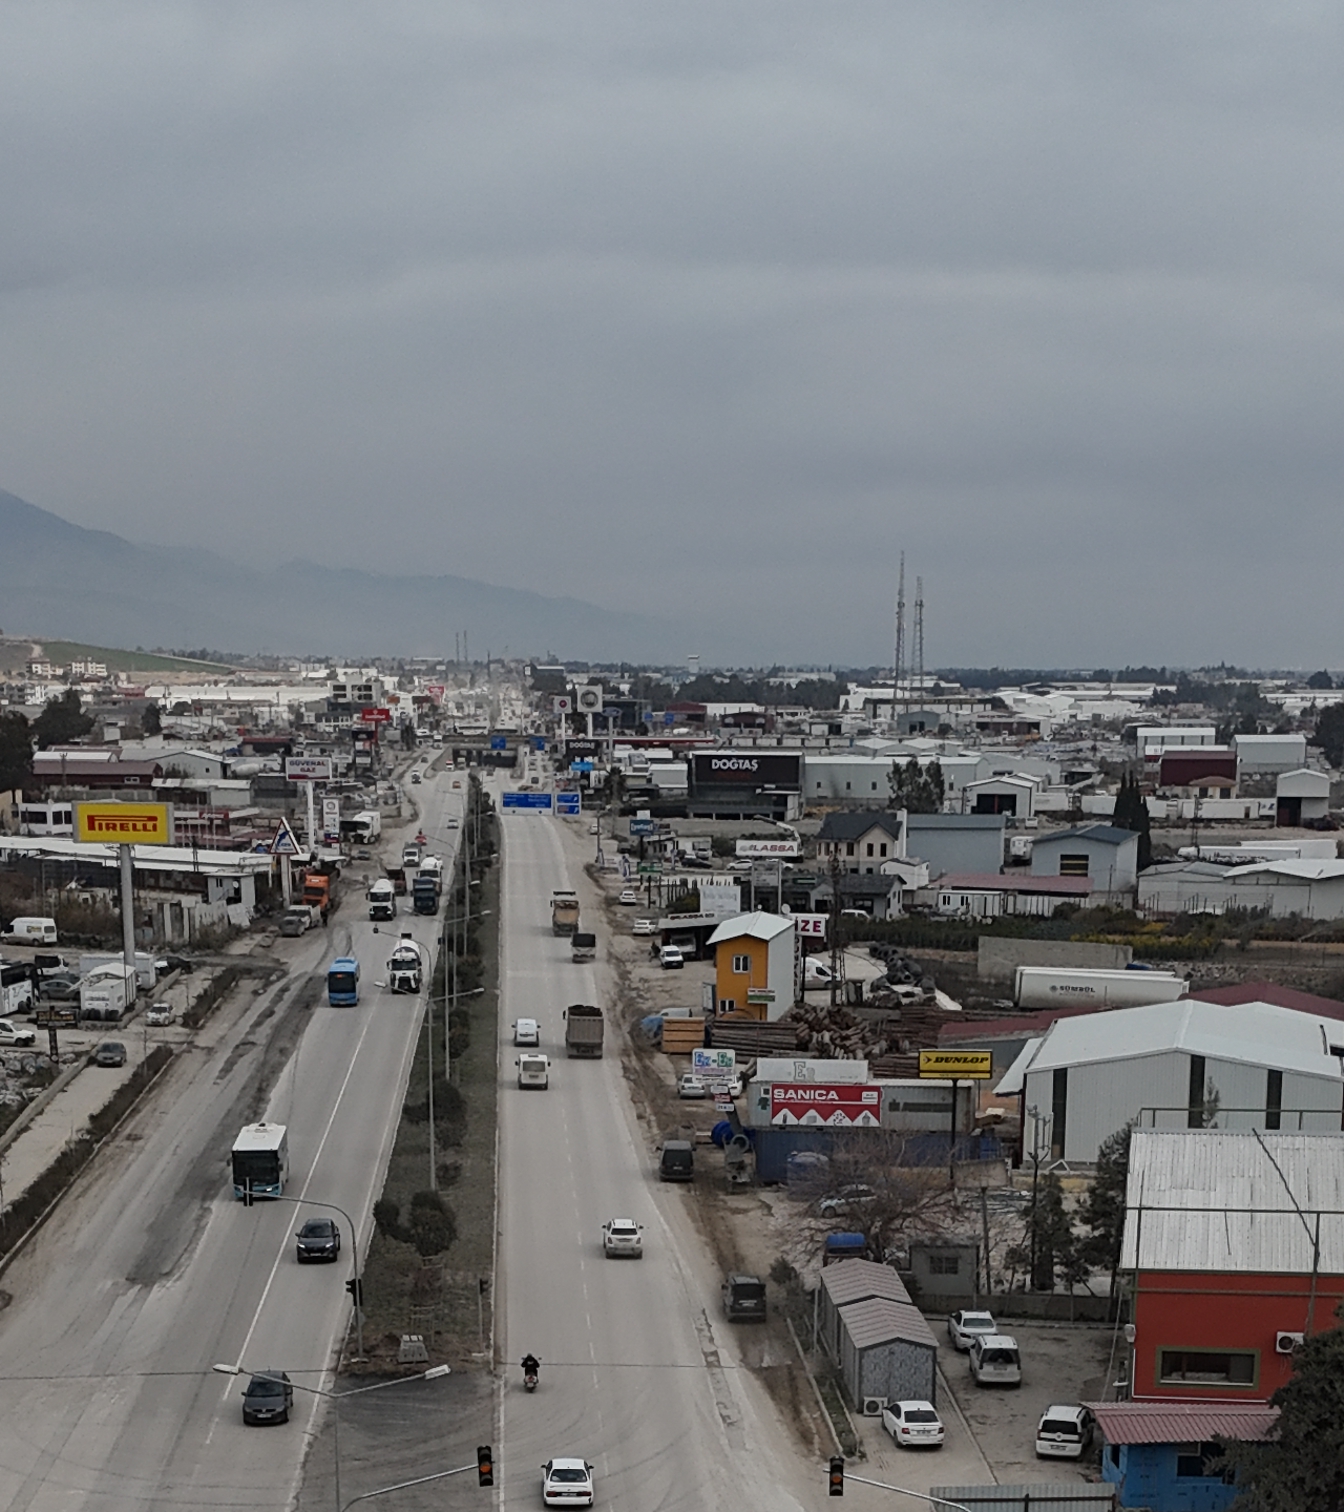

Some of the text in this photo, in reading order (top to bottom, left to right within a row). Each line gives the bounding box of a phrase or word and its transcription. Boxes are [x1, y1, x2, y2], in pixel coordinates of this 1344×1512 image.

[712, 757, 759, 772] DOĞTAŞ
[87, 815, 158, 832] PIRELLI
[753, 845, 795, 854] LASSA
[933, 1056, 989, 1065] DUNLOP
[774, 1088, 839, 1100] SANICA
